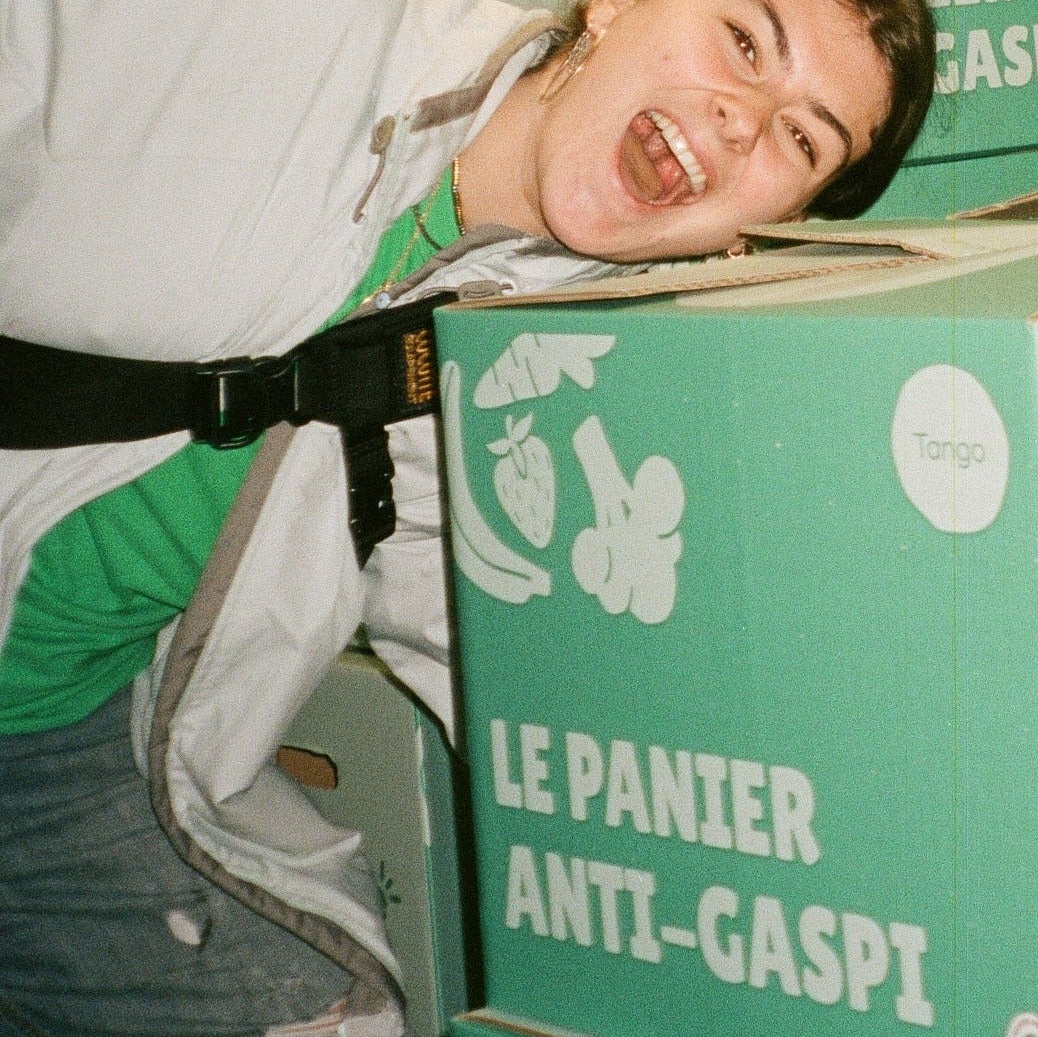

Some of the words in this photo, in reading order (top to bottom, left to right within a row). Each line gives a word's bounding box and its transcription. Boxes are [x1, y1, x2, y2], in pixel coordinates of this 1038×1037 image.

[912, 431, 986, 469] Tango
[490, 718, 554, 815] LE
[564, 731, 822, 865] PANIER
[505, 844, 935, 1027] ANTI-GASPI
